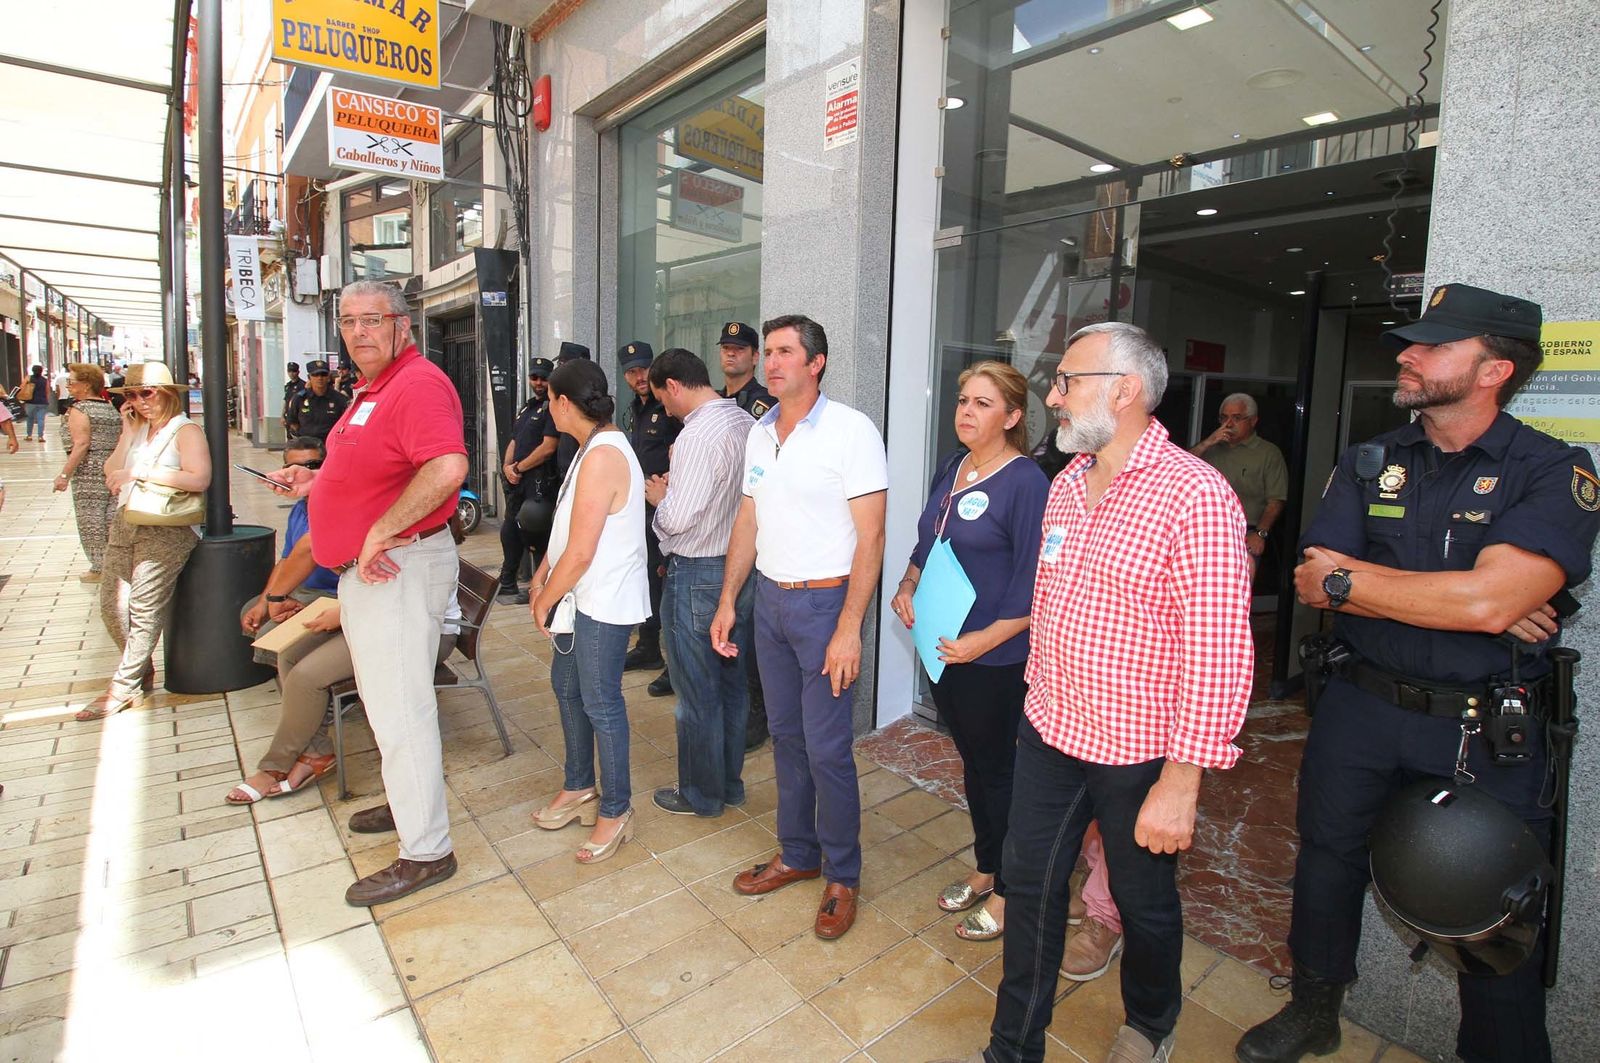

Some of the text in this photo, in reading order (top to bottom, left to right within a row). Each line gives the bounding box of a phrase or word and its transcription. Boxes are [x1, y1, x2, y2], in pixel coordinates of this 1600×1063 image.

[326, 18, 381, 35] BARBER SHOP
[281, 18, 433, 77] PELUQUEROS
[827, 96, 858, 113] Alarma
[336, 111, 439, 140] PELUQUERIA
[336, 146, 441, 175] Caballeros y Niños
[236, 248, 256, 310] TRIBECA
[1540, 340, 1593, 348] GOBIERNO
[1551, 373, 1568, 382] del
[1568, 395, 1584, 405] del
